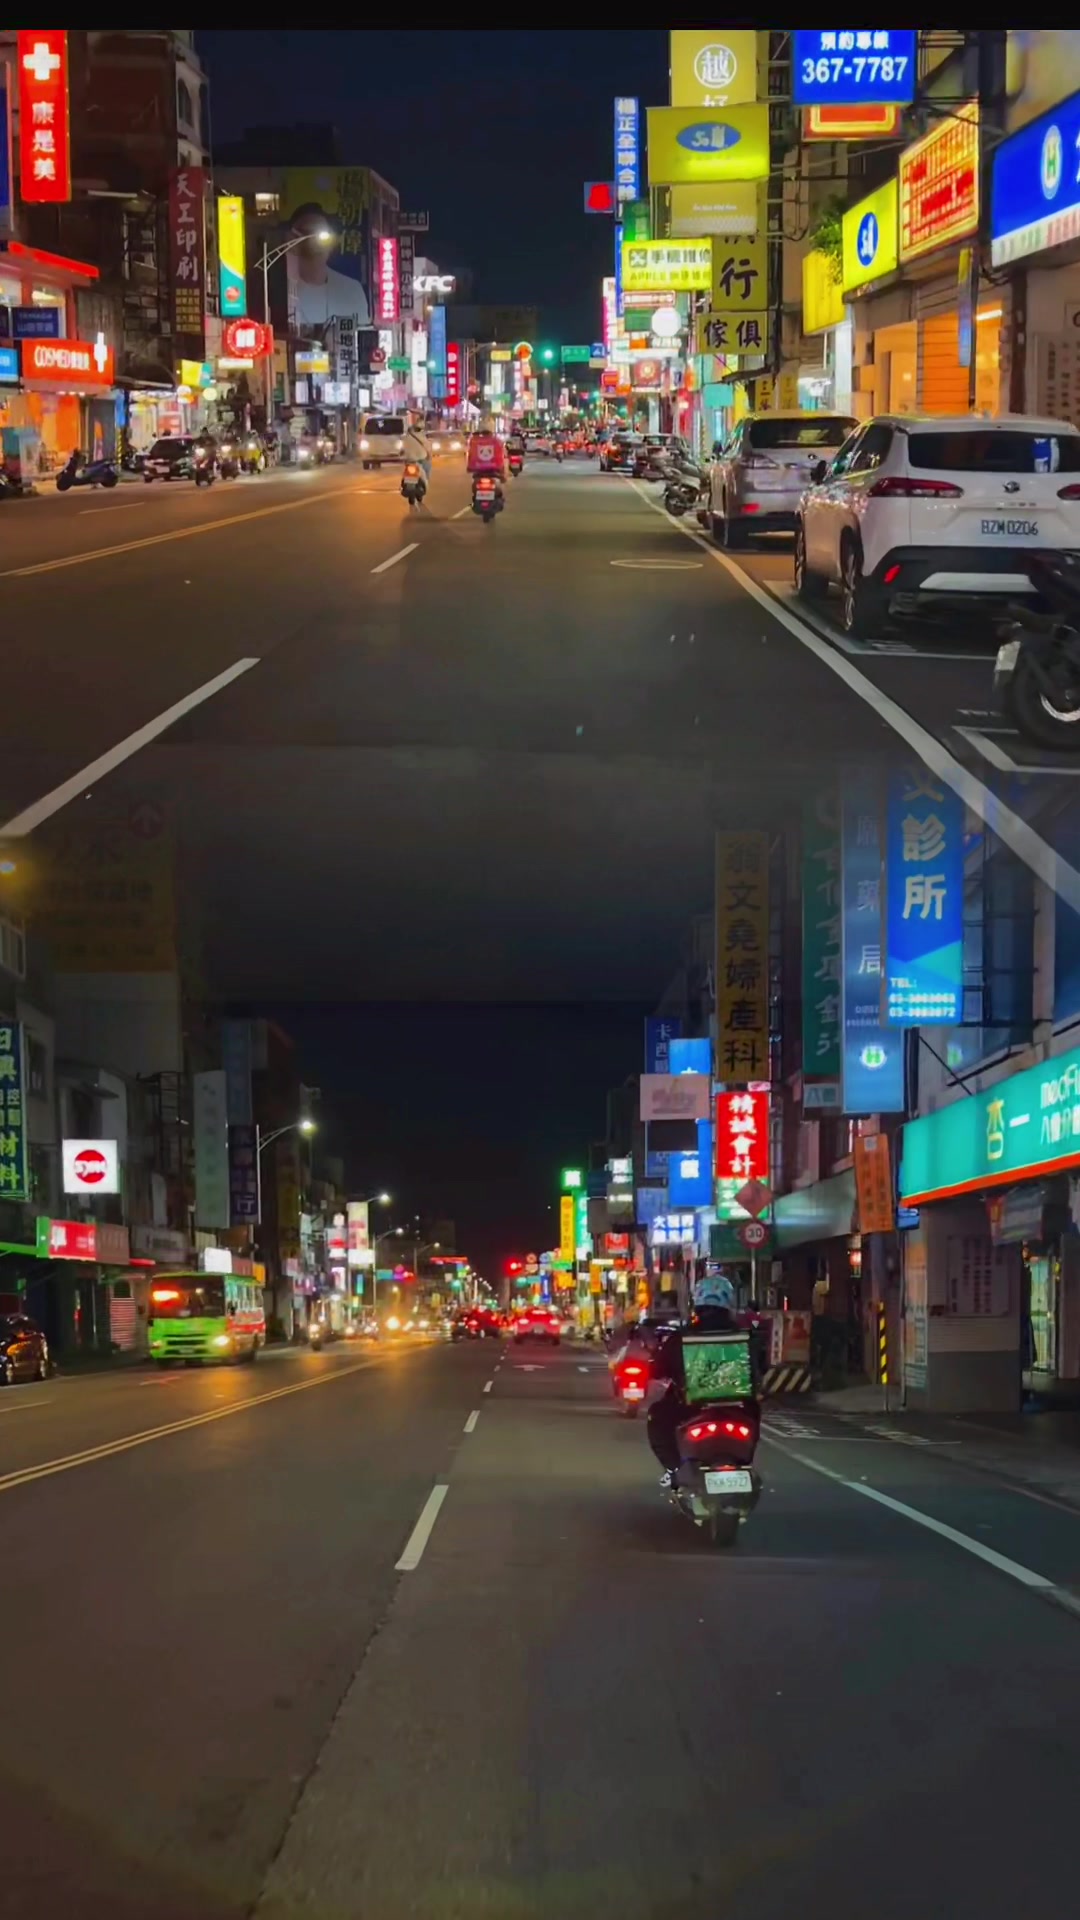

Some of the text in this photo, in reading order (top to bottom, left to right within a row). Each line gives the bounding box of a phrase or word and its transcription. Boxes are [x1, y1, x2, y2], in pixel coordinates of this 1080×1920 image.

[802, 56, 909, 84] 367-7787
[32, 100, 56, 182] 康是美
[176, 173, 199, 284] 天工印刷
[413, 273, 457, 293] KFC
[704, 318, 763, 349] 傢俱
[729, 1094, 758, 1176] 精誠會計
[748, 1225, 763, 1239] 30
